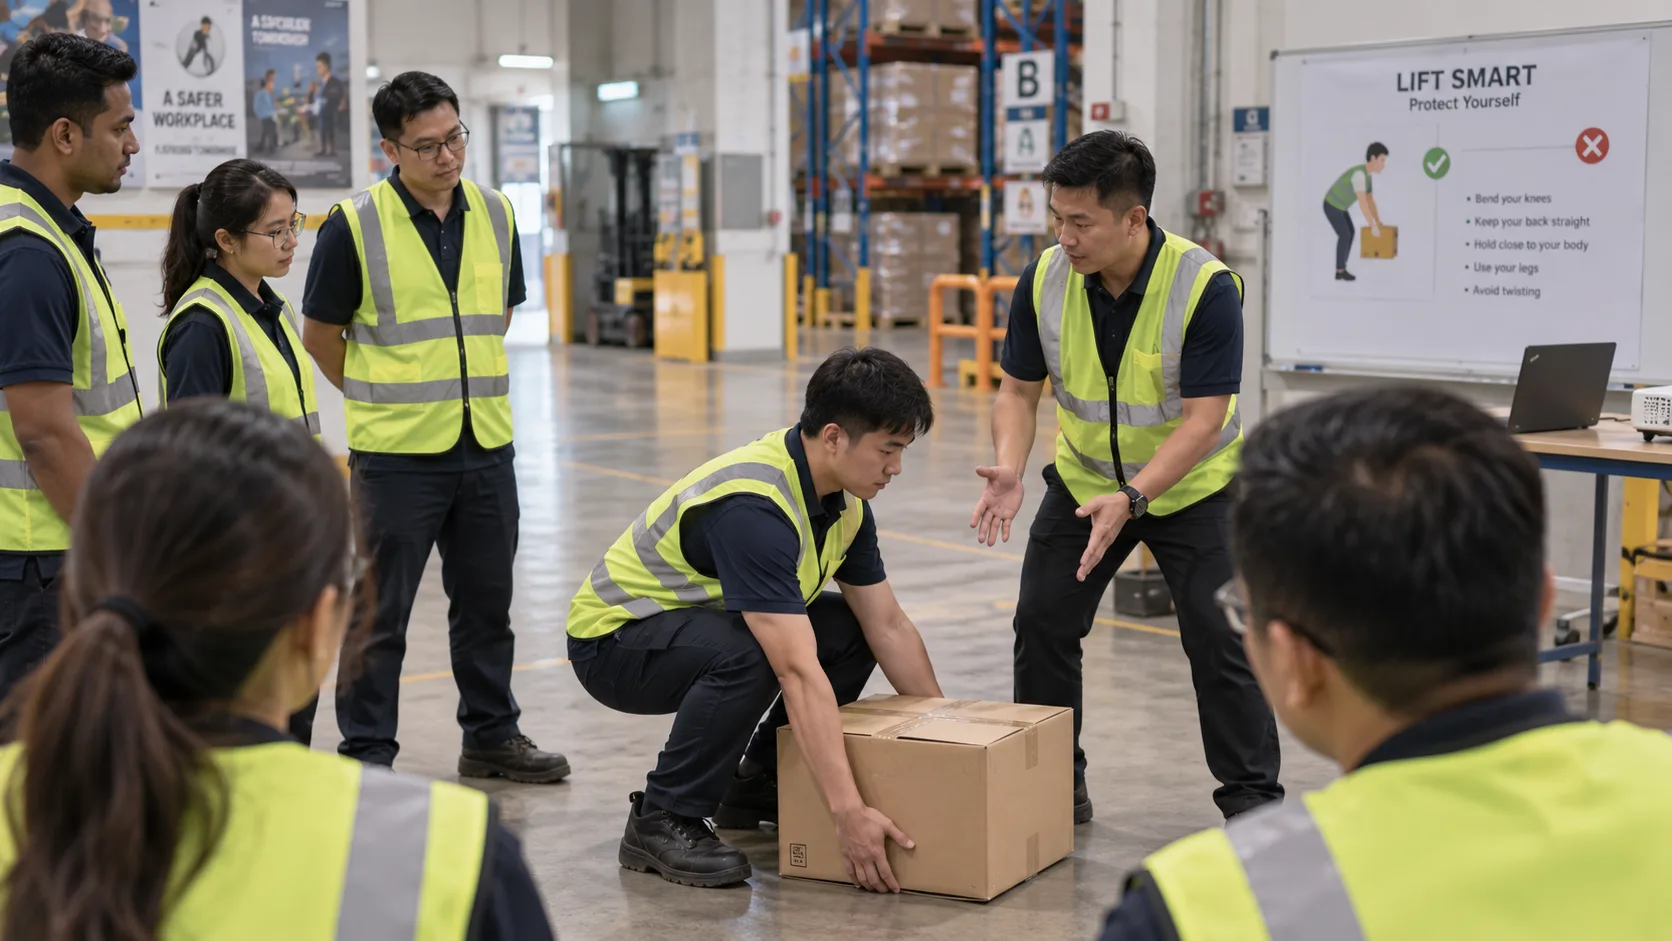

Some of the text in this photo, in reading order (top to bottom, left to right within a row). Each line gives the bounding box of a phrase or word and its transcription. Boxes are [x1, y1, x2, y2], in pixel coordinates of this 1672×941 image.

[1018, 60, 1038, 98] B
[1397, 64, 1537, 92] LIFT SMART
[163, 90, 223, 108] A SAFER
[1409, 92, 1520, 111] Protect Yourself
[153, 112, 235, 129] WORKPLACE
[1475, 193, 1552, 206] Bend your knees
[1475, 216, 1590, 229] Keep your back straight
[1474, 240, 1589, 252] Hold close to your body
[1474, 262, 1539, 276] Use your legs
[1473, 285, 1541, 299] Avoid twisting
